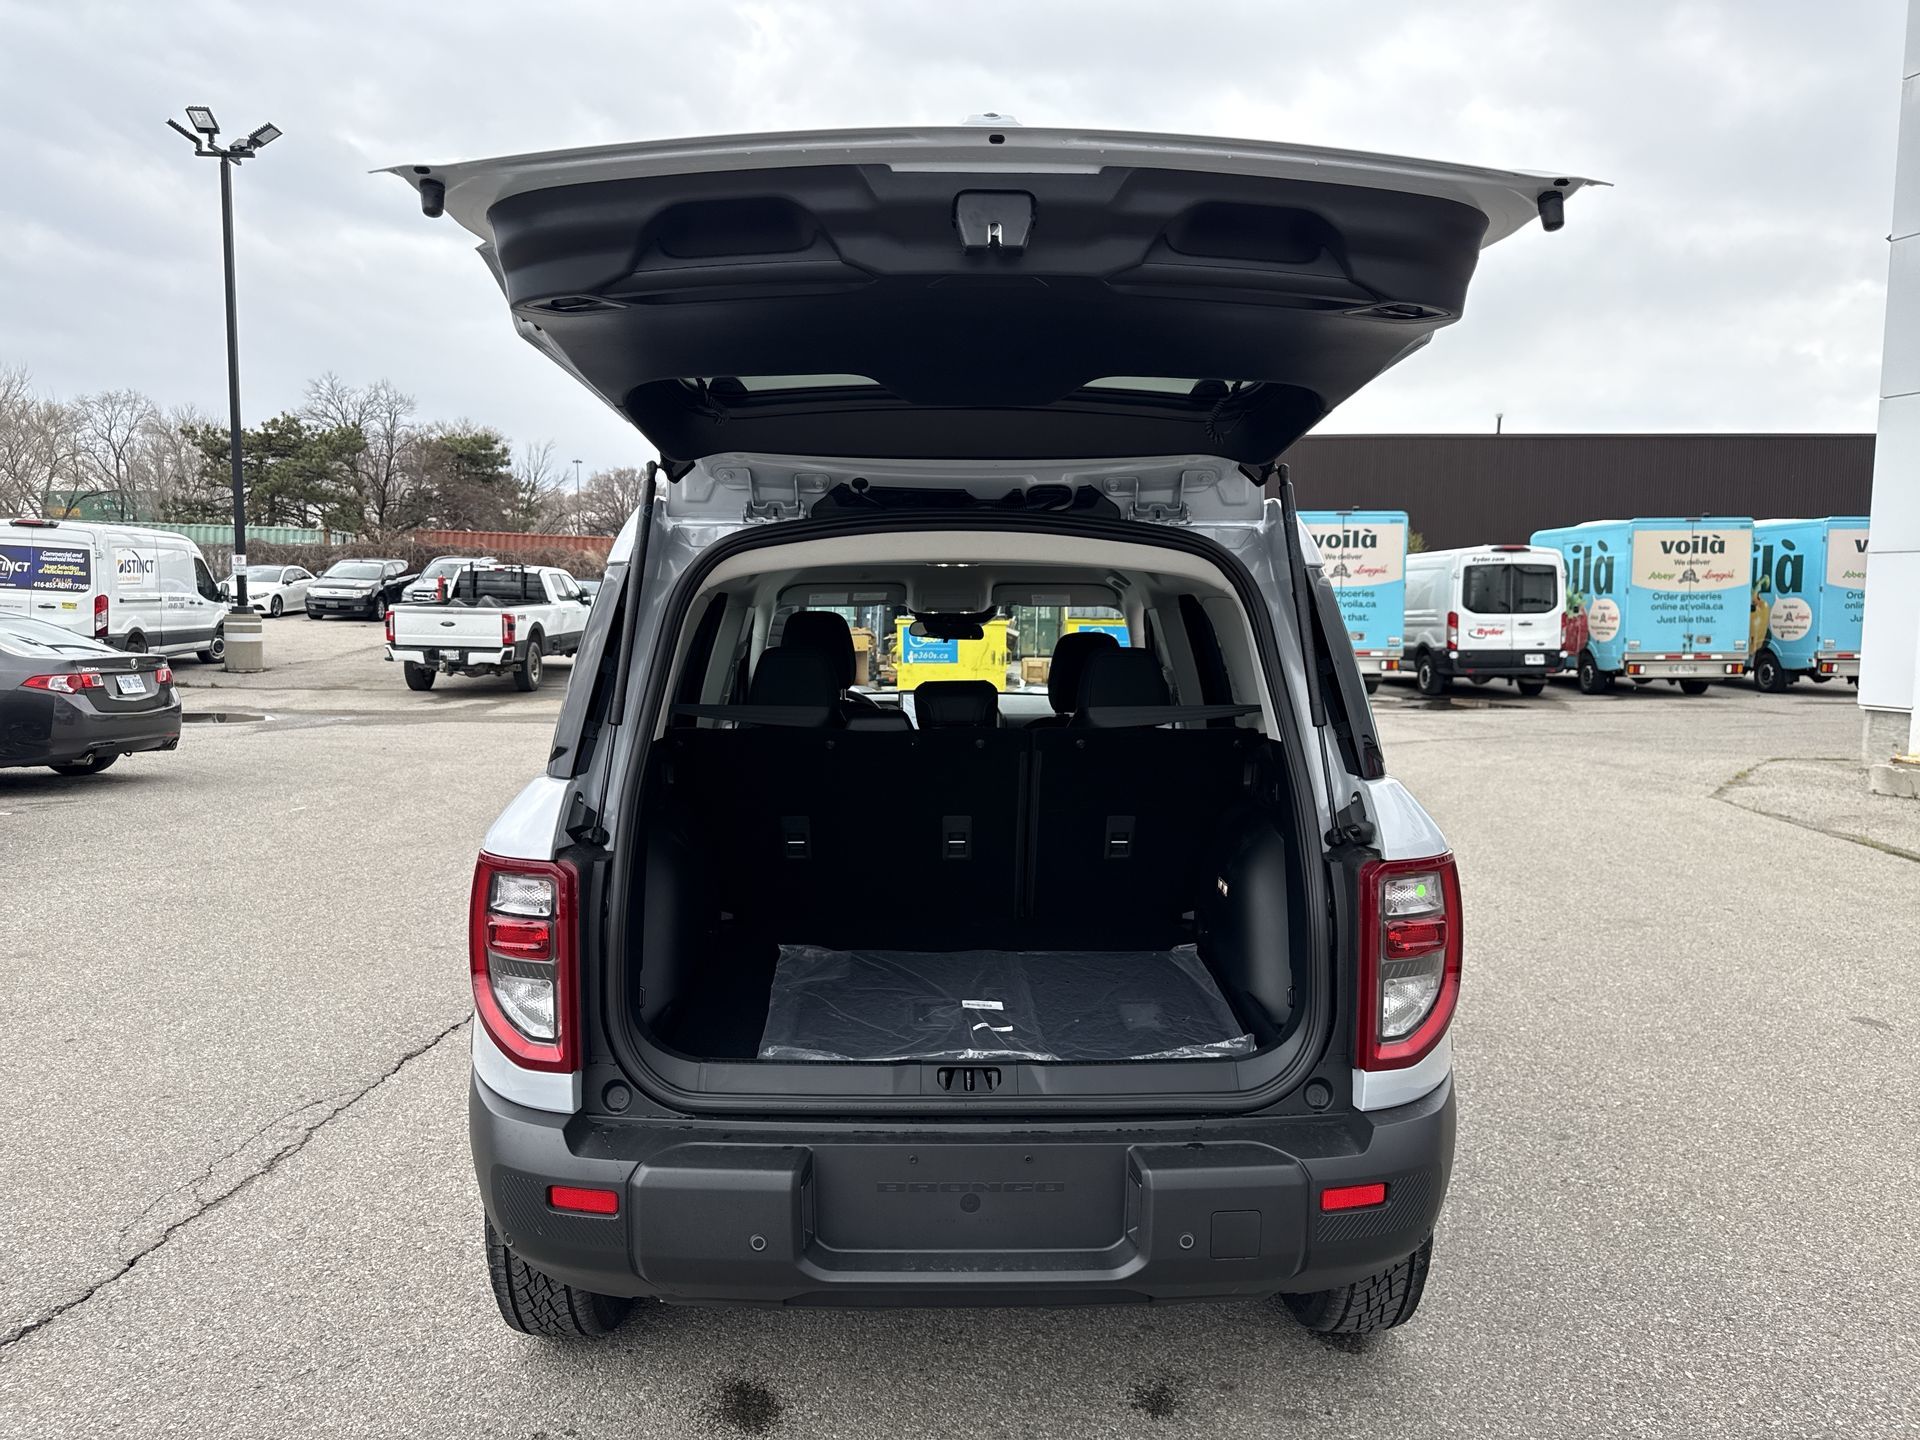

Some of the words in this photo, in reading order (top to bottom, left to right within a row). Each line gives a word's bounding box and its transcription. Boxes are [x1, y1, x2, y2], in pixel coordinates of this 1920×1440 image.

[1660, 534, 1726, 554] voilà
[117, 559, 154, 574] DISTINCT
[1686, 558, 1710, 566] deliver
[1652, 592, 1678, 600] Order
[1679, 592, 1722, 603] groceries
[1650, 602, 1678, 611] online
[1679, 603, 1689, 611] at
[1690, 602, 1724, 611] voila.ca
[1656, 615, 1677, 624] Just
[1678, 615, 1694, 624] like
[1695, 615, 1716, 624] that.
[1476, 627, 1505, 637] Ryder
